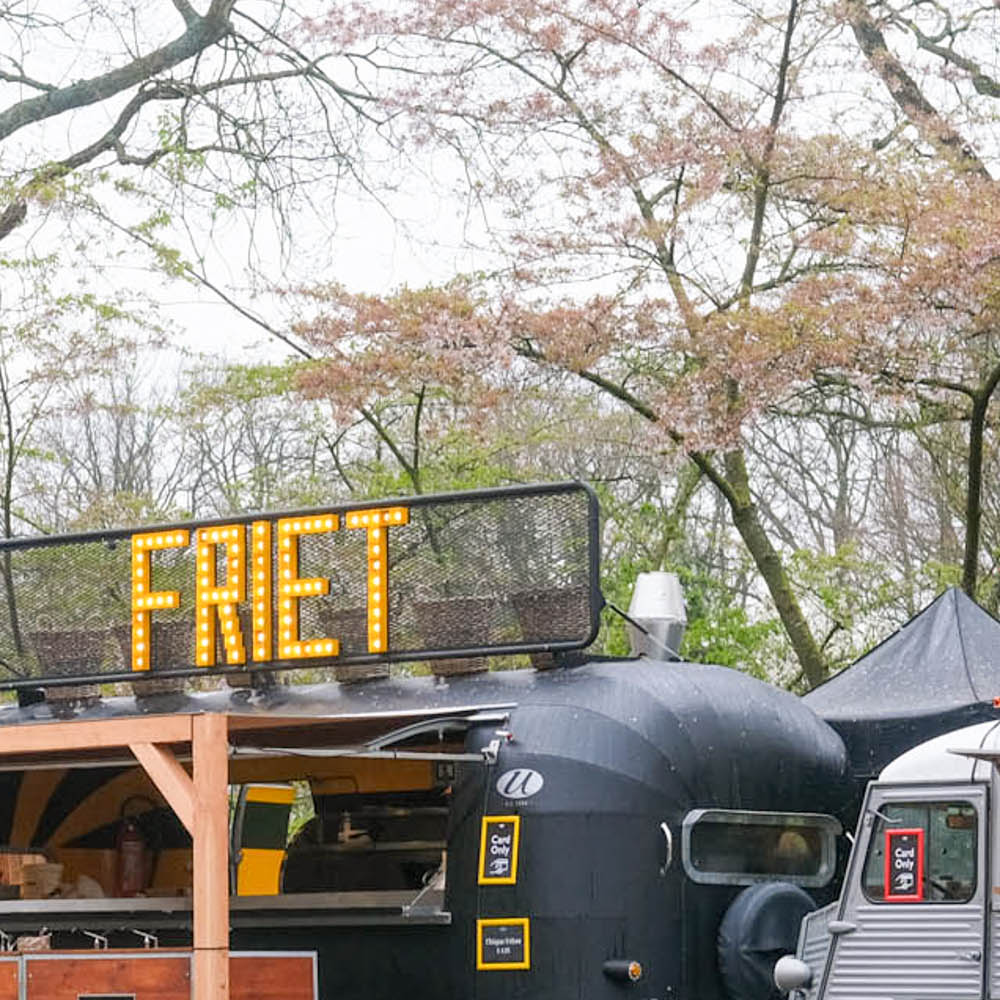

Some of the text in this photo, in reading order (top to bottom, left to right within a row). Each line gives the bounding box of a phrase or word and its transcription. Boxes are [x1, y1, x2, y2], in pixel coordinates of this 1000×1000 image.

[131, 507, 409, 671] FRIET
[491, 834, 511, 845] Card
[490, 844, 511, 857] Only
[895, 847, 914, 858] Card
[895, 858, 914, 871] Only
